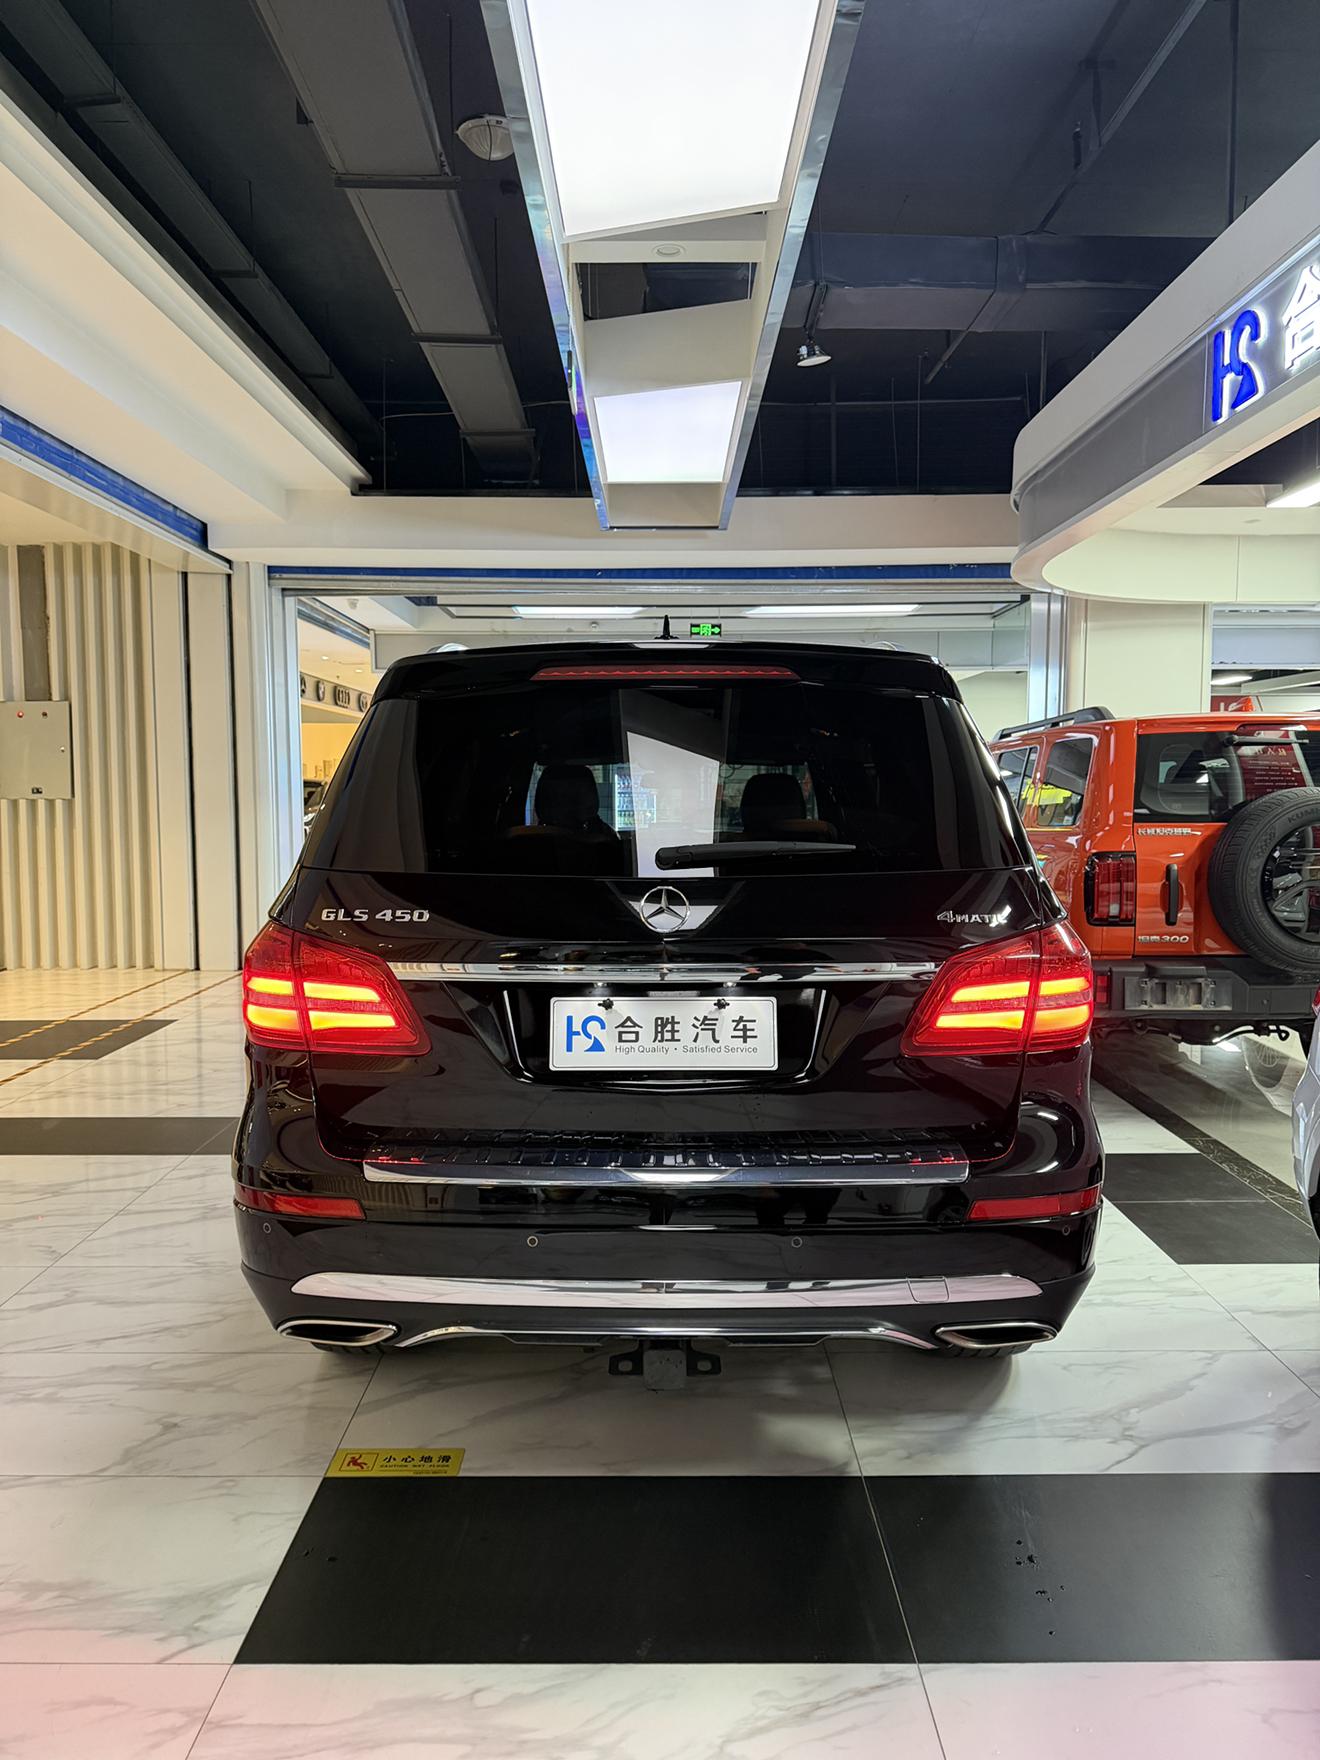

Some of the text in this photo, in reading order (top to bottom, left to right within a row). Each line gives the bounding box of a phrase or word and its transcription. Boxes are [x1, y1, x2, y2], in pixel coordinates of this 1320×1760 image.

[321, 908, 430, 922] GLS 450
[614, 1015, 758, 1044] 合胜汽车
[615, 1045, 758, 1055] High Quality Satisfied Service
[383, 1455, 452, 1463] 小心地滑
